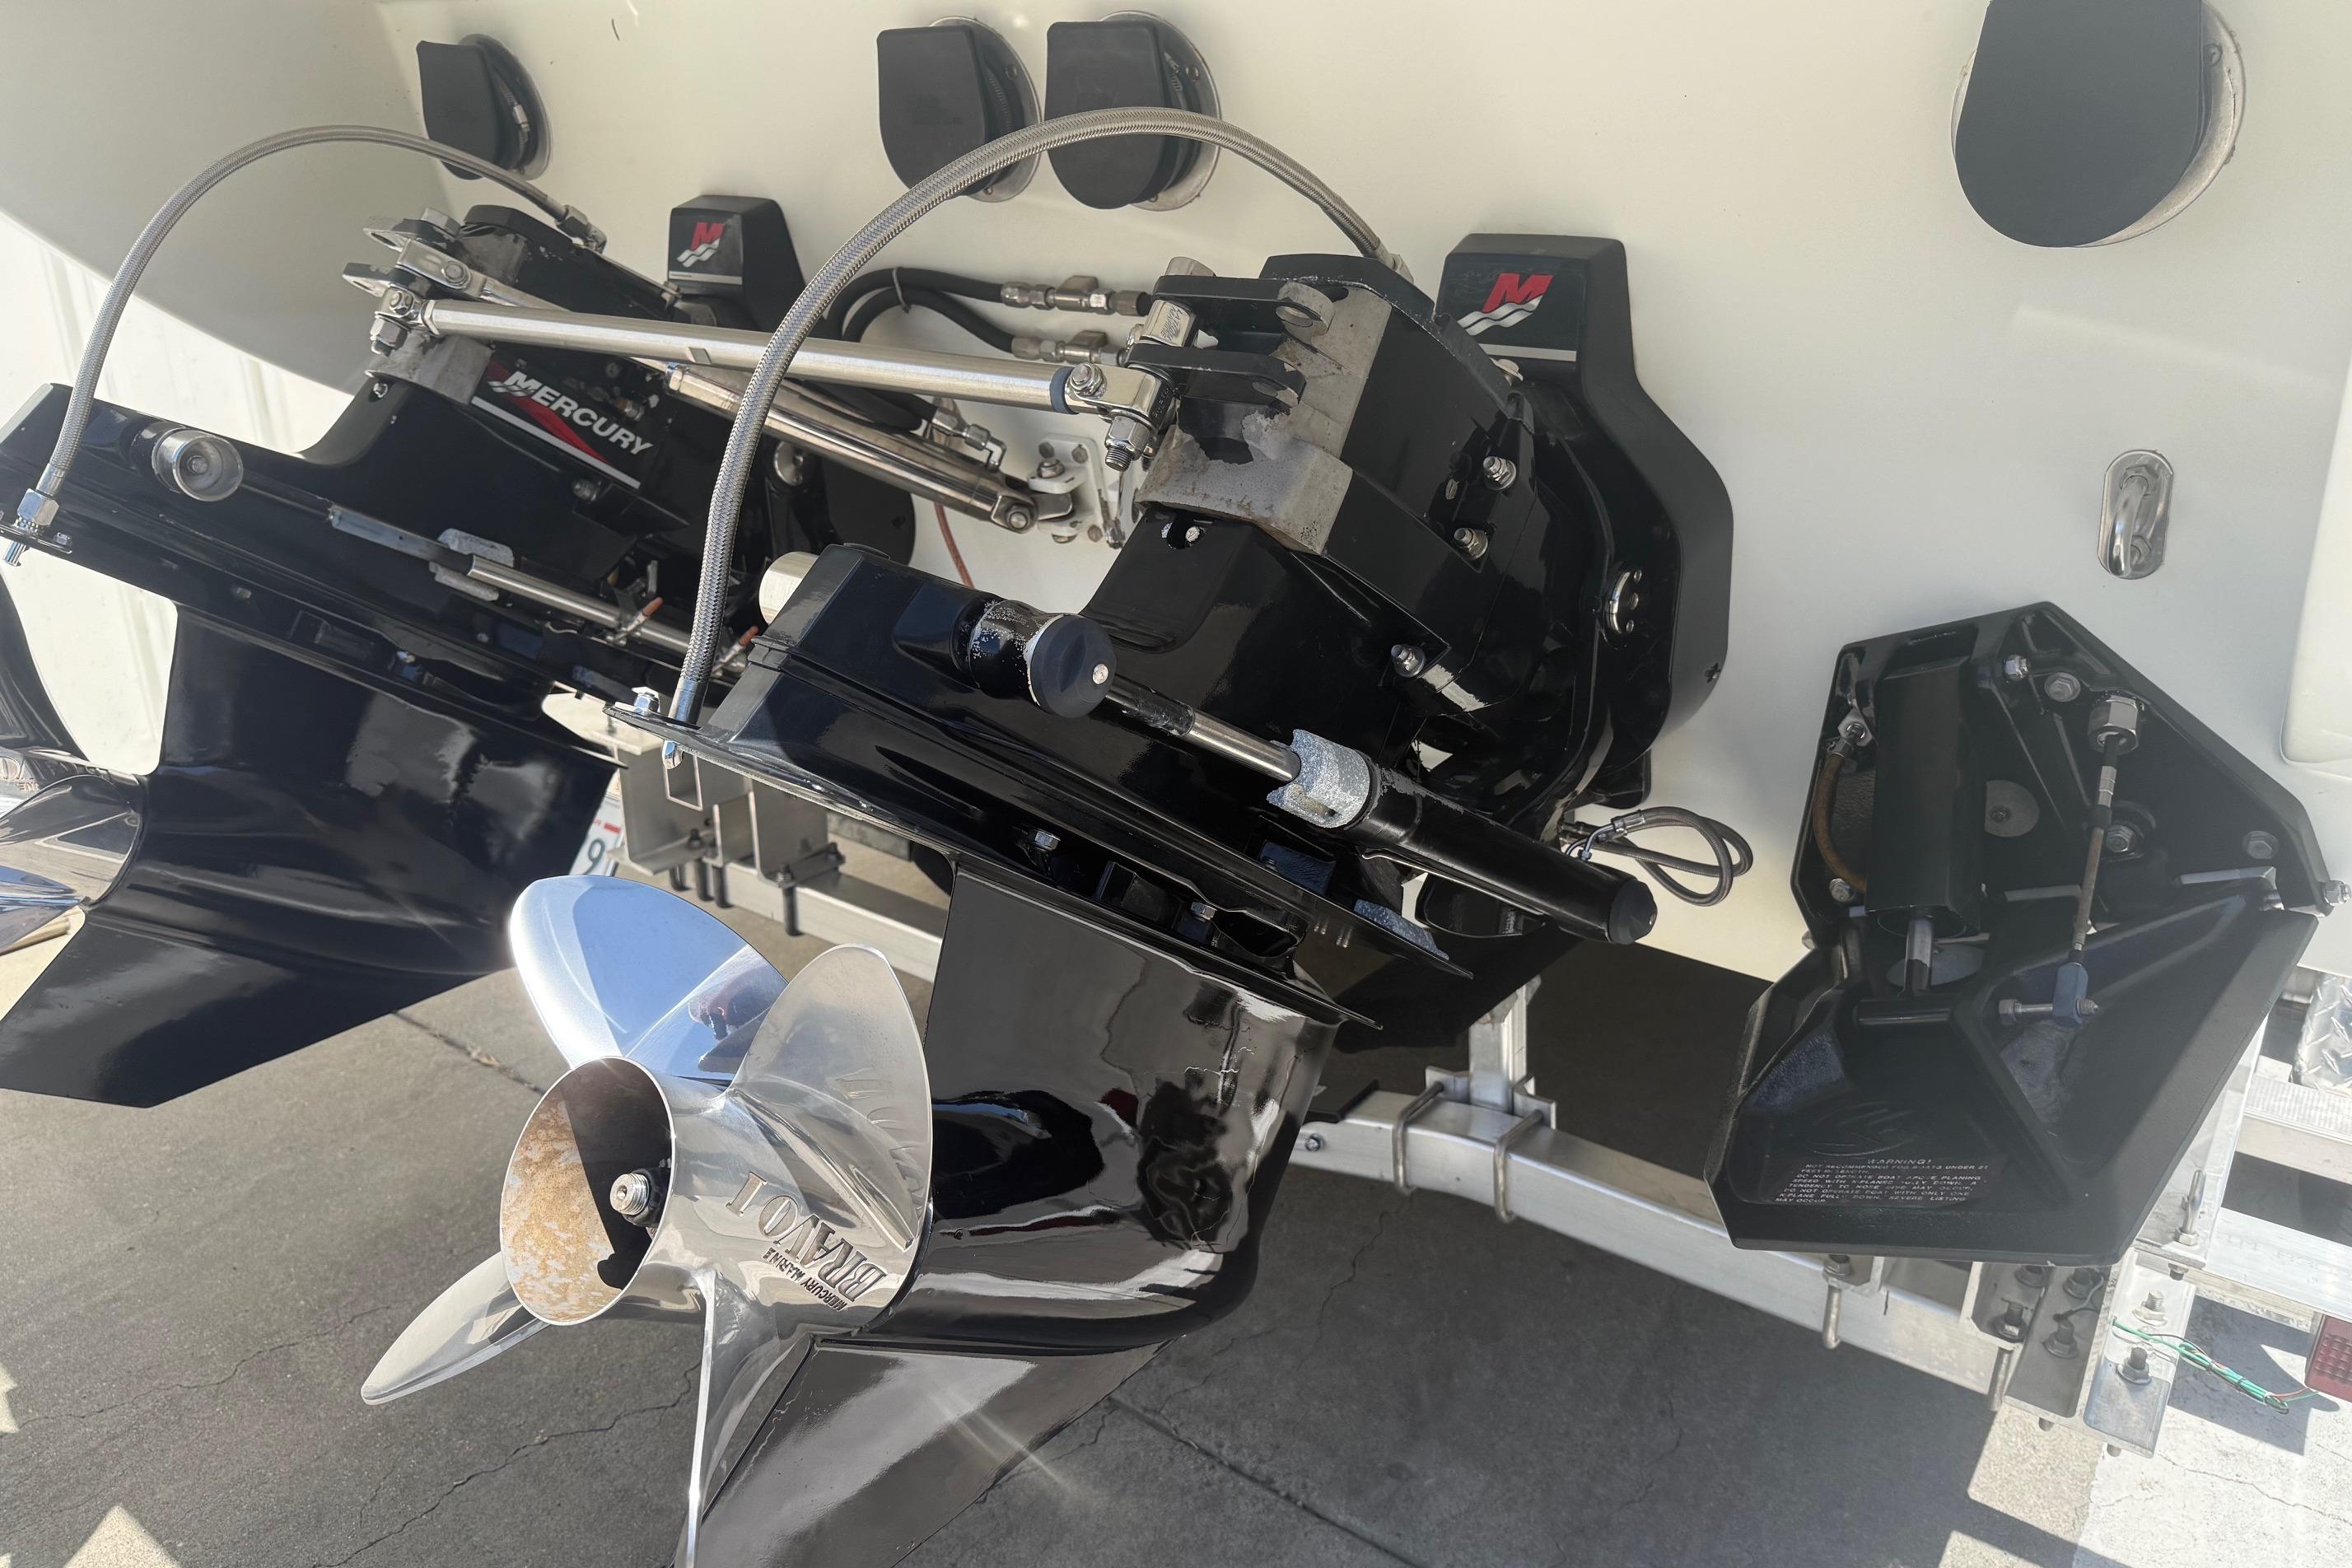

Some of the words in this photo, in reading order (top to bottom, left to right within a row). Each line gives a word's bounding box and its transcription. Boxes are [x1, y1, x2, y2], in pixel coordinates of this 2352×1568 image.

[501, 371, 653, 455] MERCURY
[758, 1194, 888, 1303] BRAVO
[761, 1247, 805, 1282] MARINE
[800, 1276, 848, 1312] MERCURY
